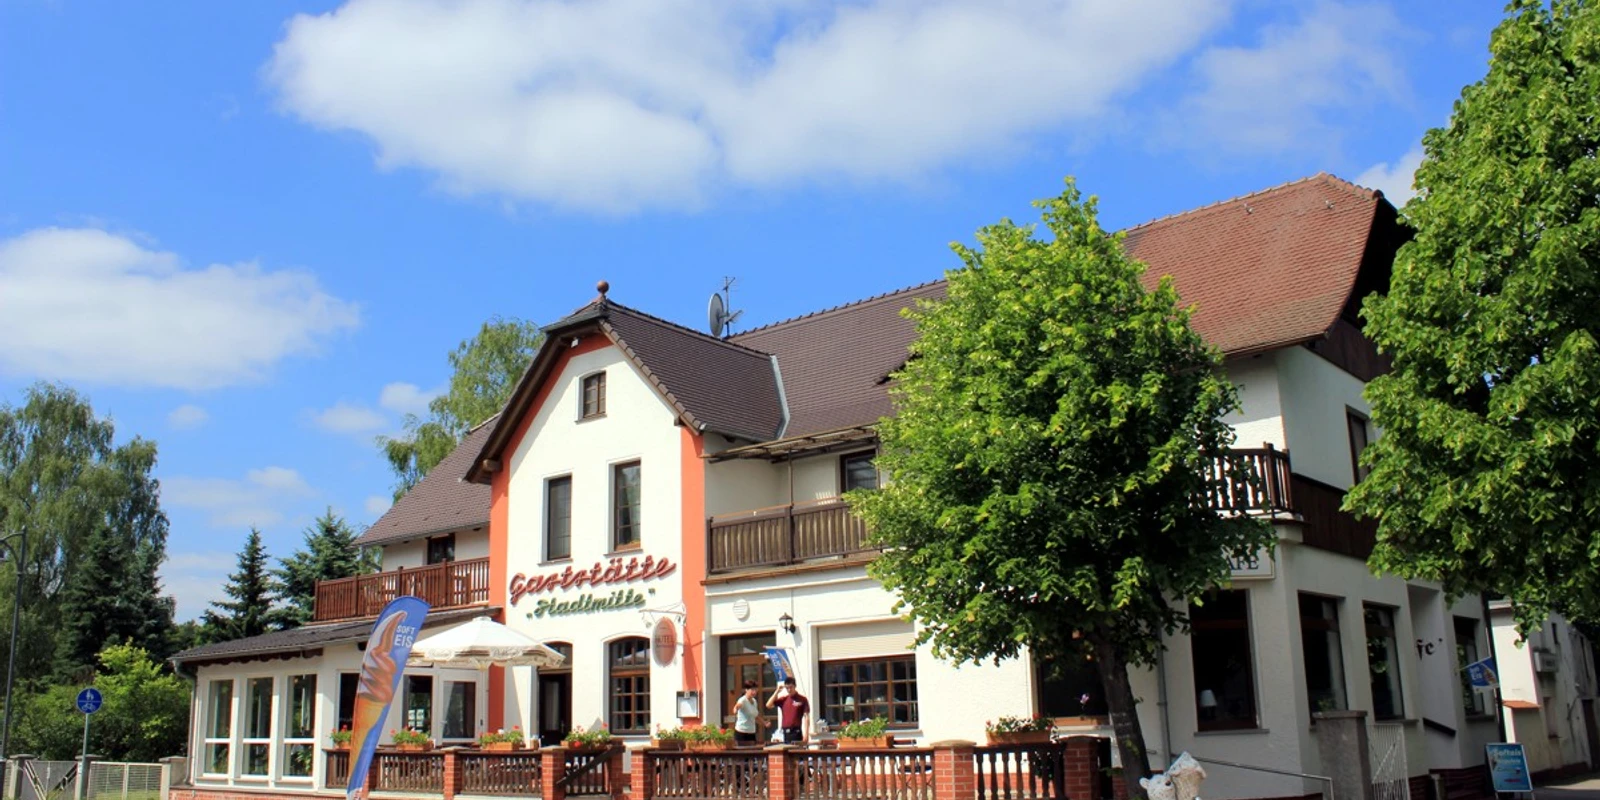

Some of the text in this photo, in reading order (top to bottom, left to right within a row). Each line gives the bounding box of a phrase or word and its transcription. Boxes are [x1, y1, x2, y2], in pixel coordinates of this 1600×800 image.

[509, 555, 677, 605] Gaststätte
[396, 625, 416, 635] SOFT
[394, 634, 414, 648] EIS
